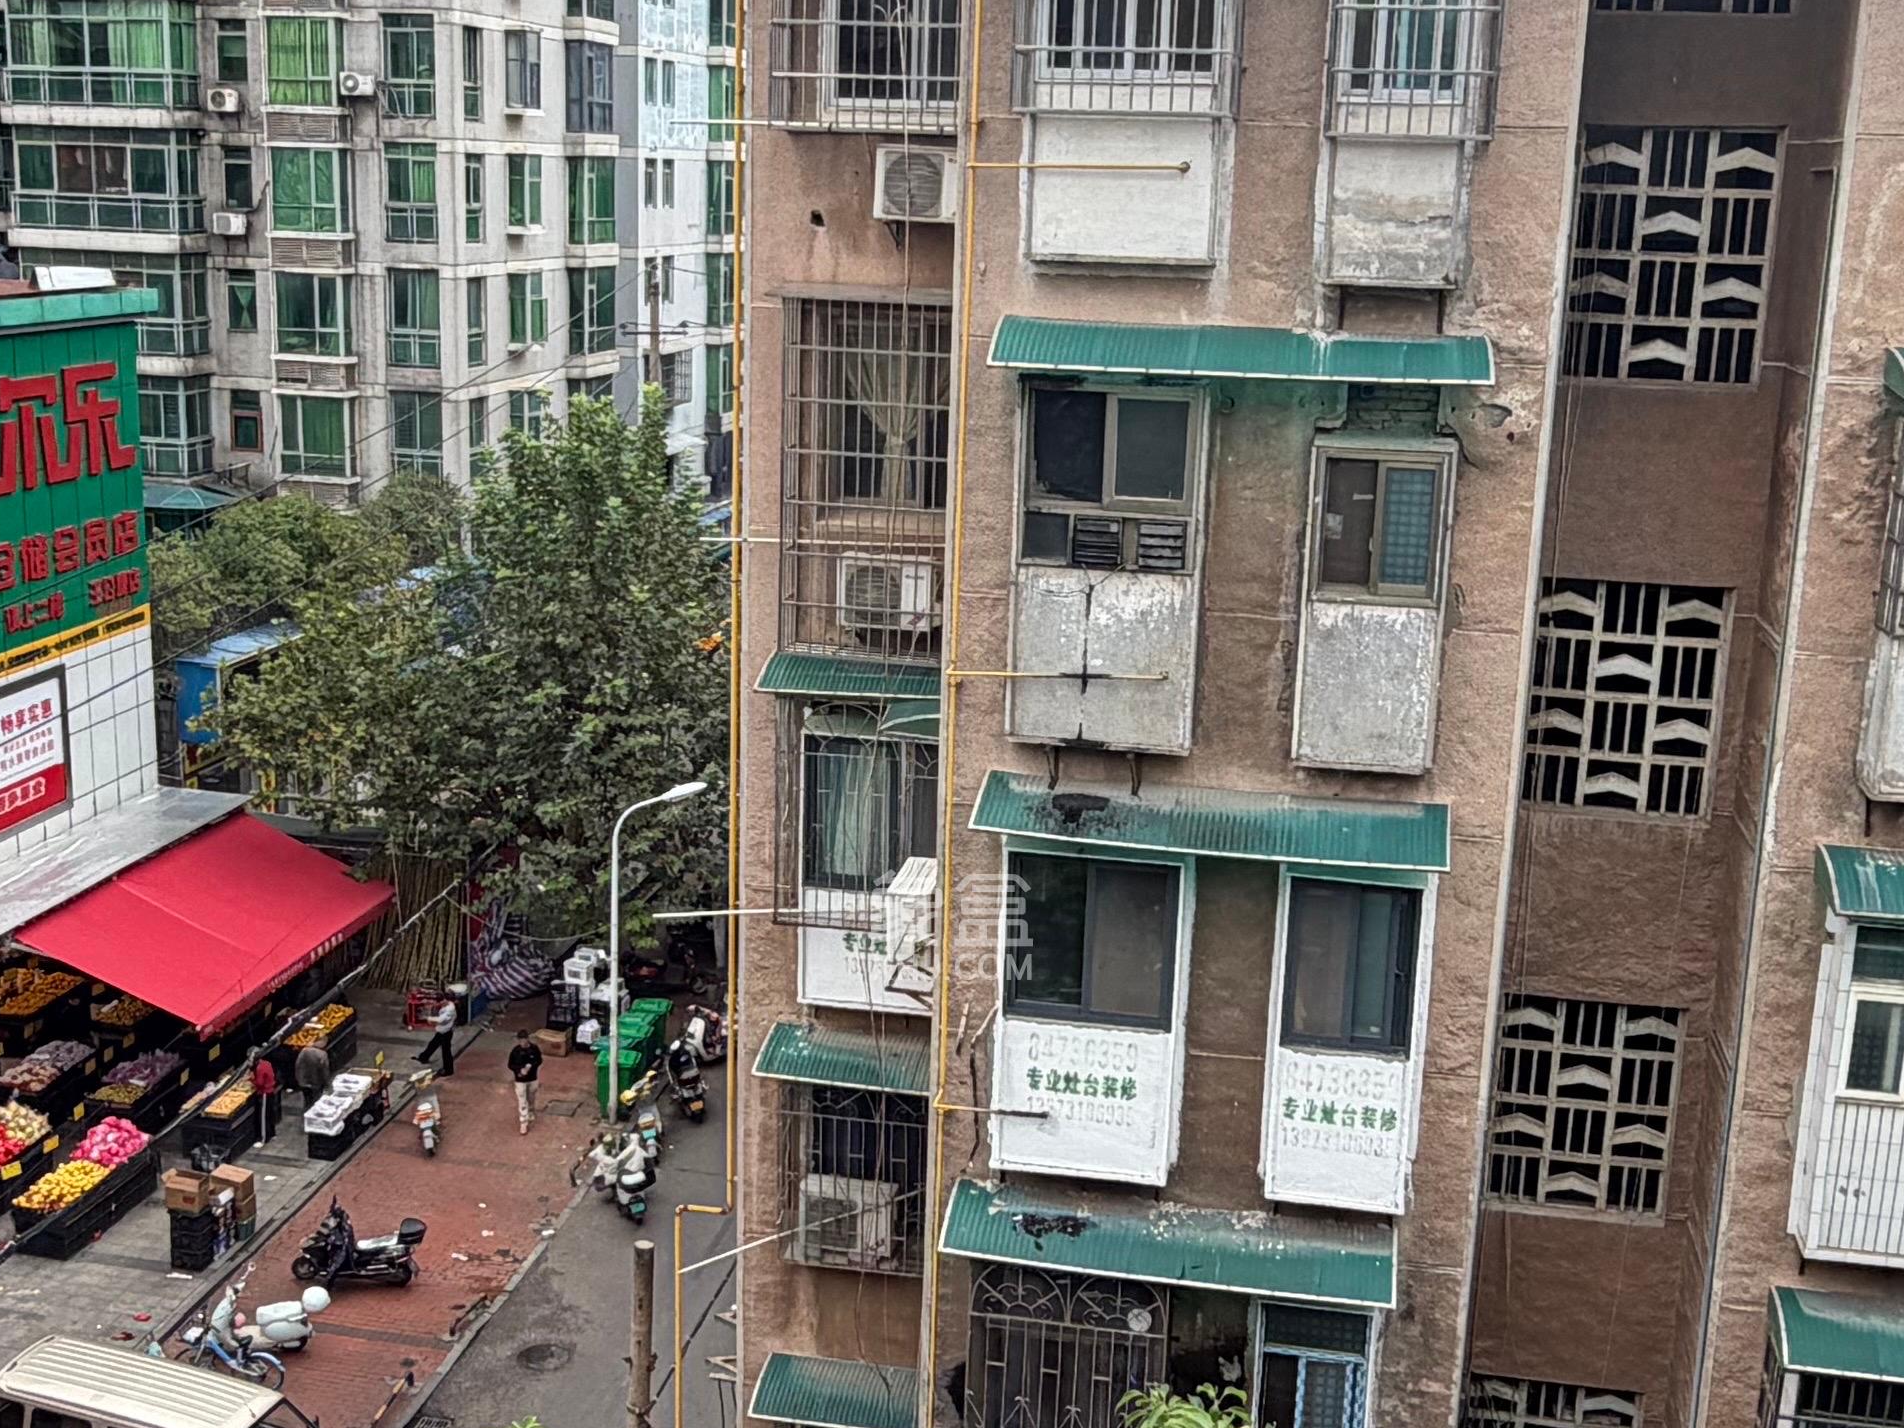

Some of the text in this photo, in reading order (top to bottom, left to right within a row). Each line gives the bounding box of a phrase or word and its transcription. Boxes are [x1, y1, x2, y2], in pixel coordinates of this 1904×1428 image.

[1026, 1066, 1137, 1101] 专业灶台装修
[1282, 1096, 1397, 1132] 专业灶台装修
